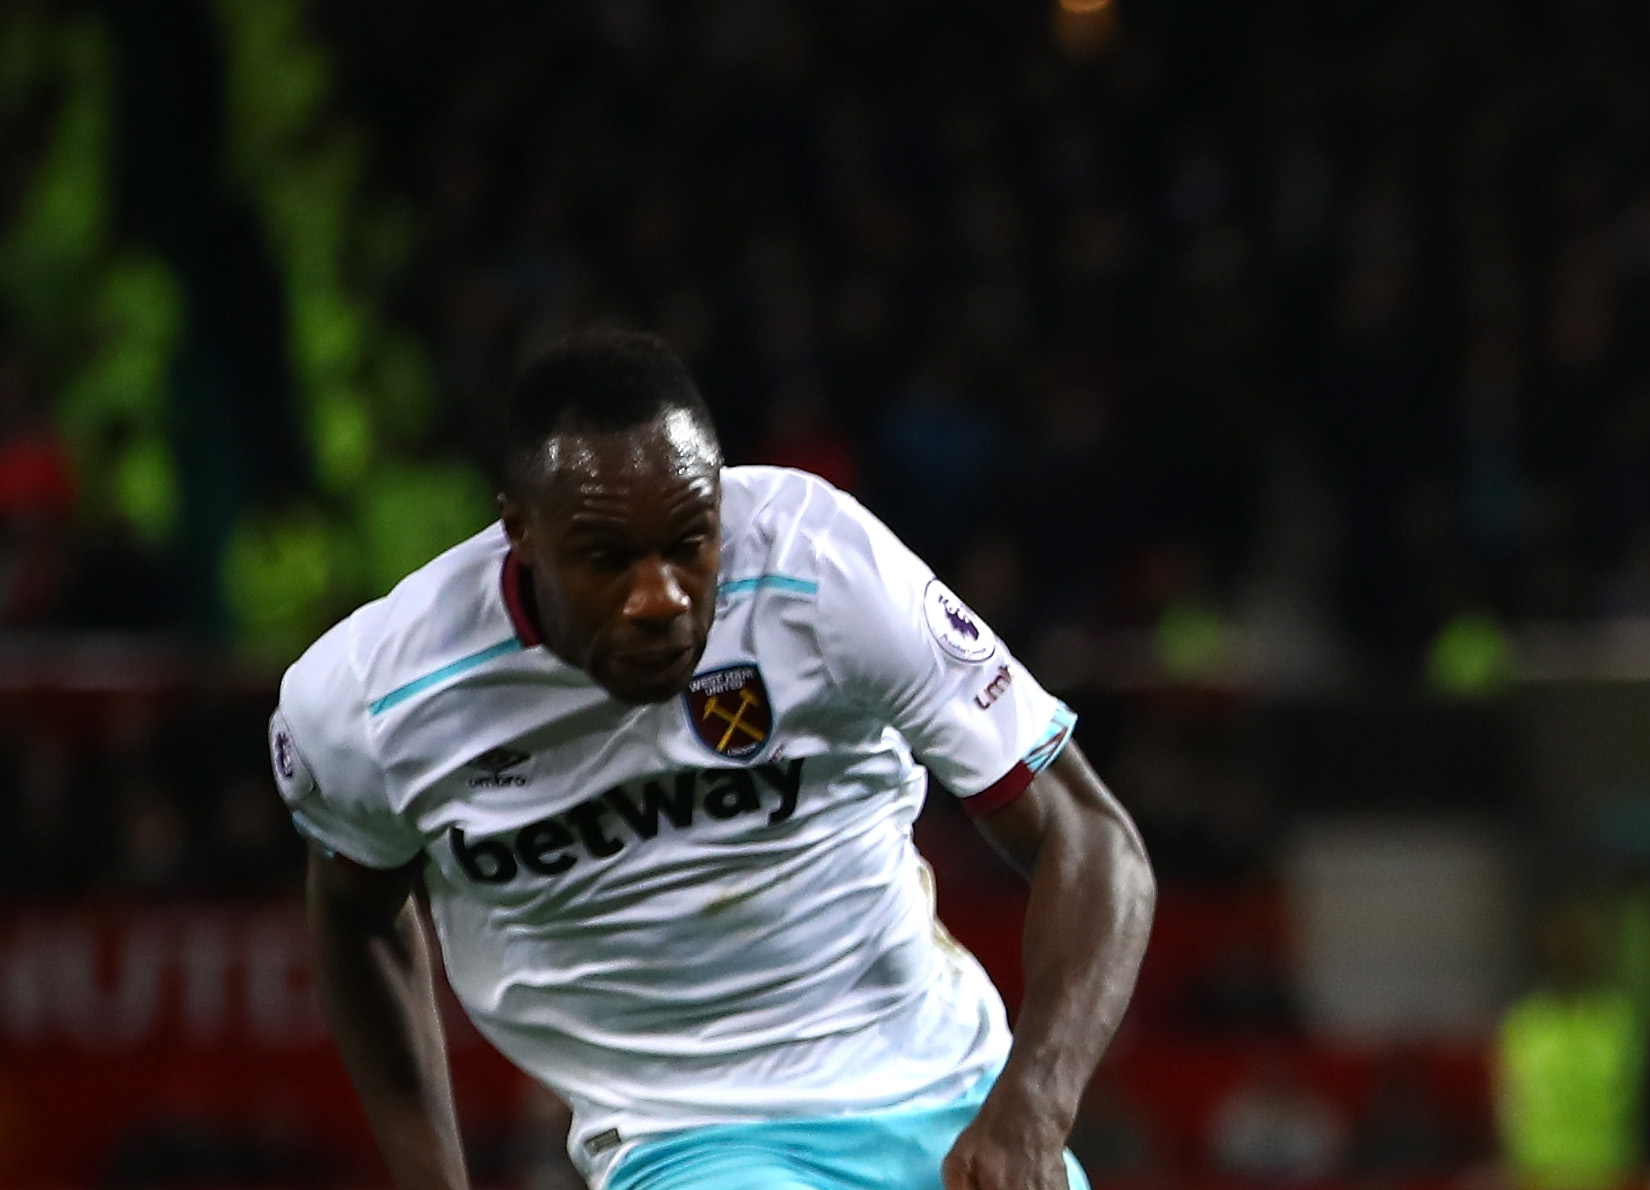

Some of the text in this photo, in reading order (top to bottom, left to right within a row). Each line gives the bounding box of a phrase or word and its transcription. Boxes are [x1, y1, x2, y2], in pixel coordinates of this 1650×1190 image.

[688, 668, 756, 693] WEST HAM
[704, 680, 746, 697] UNITED
[450, 756, 804, 885] betway
